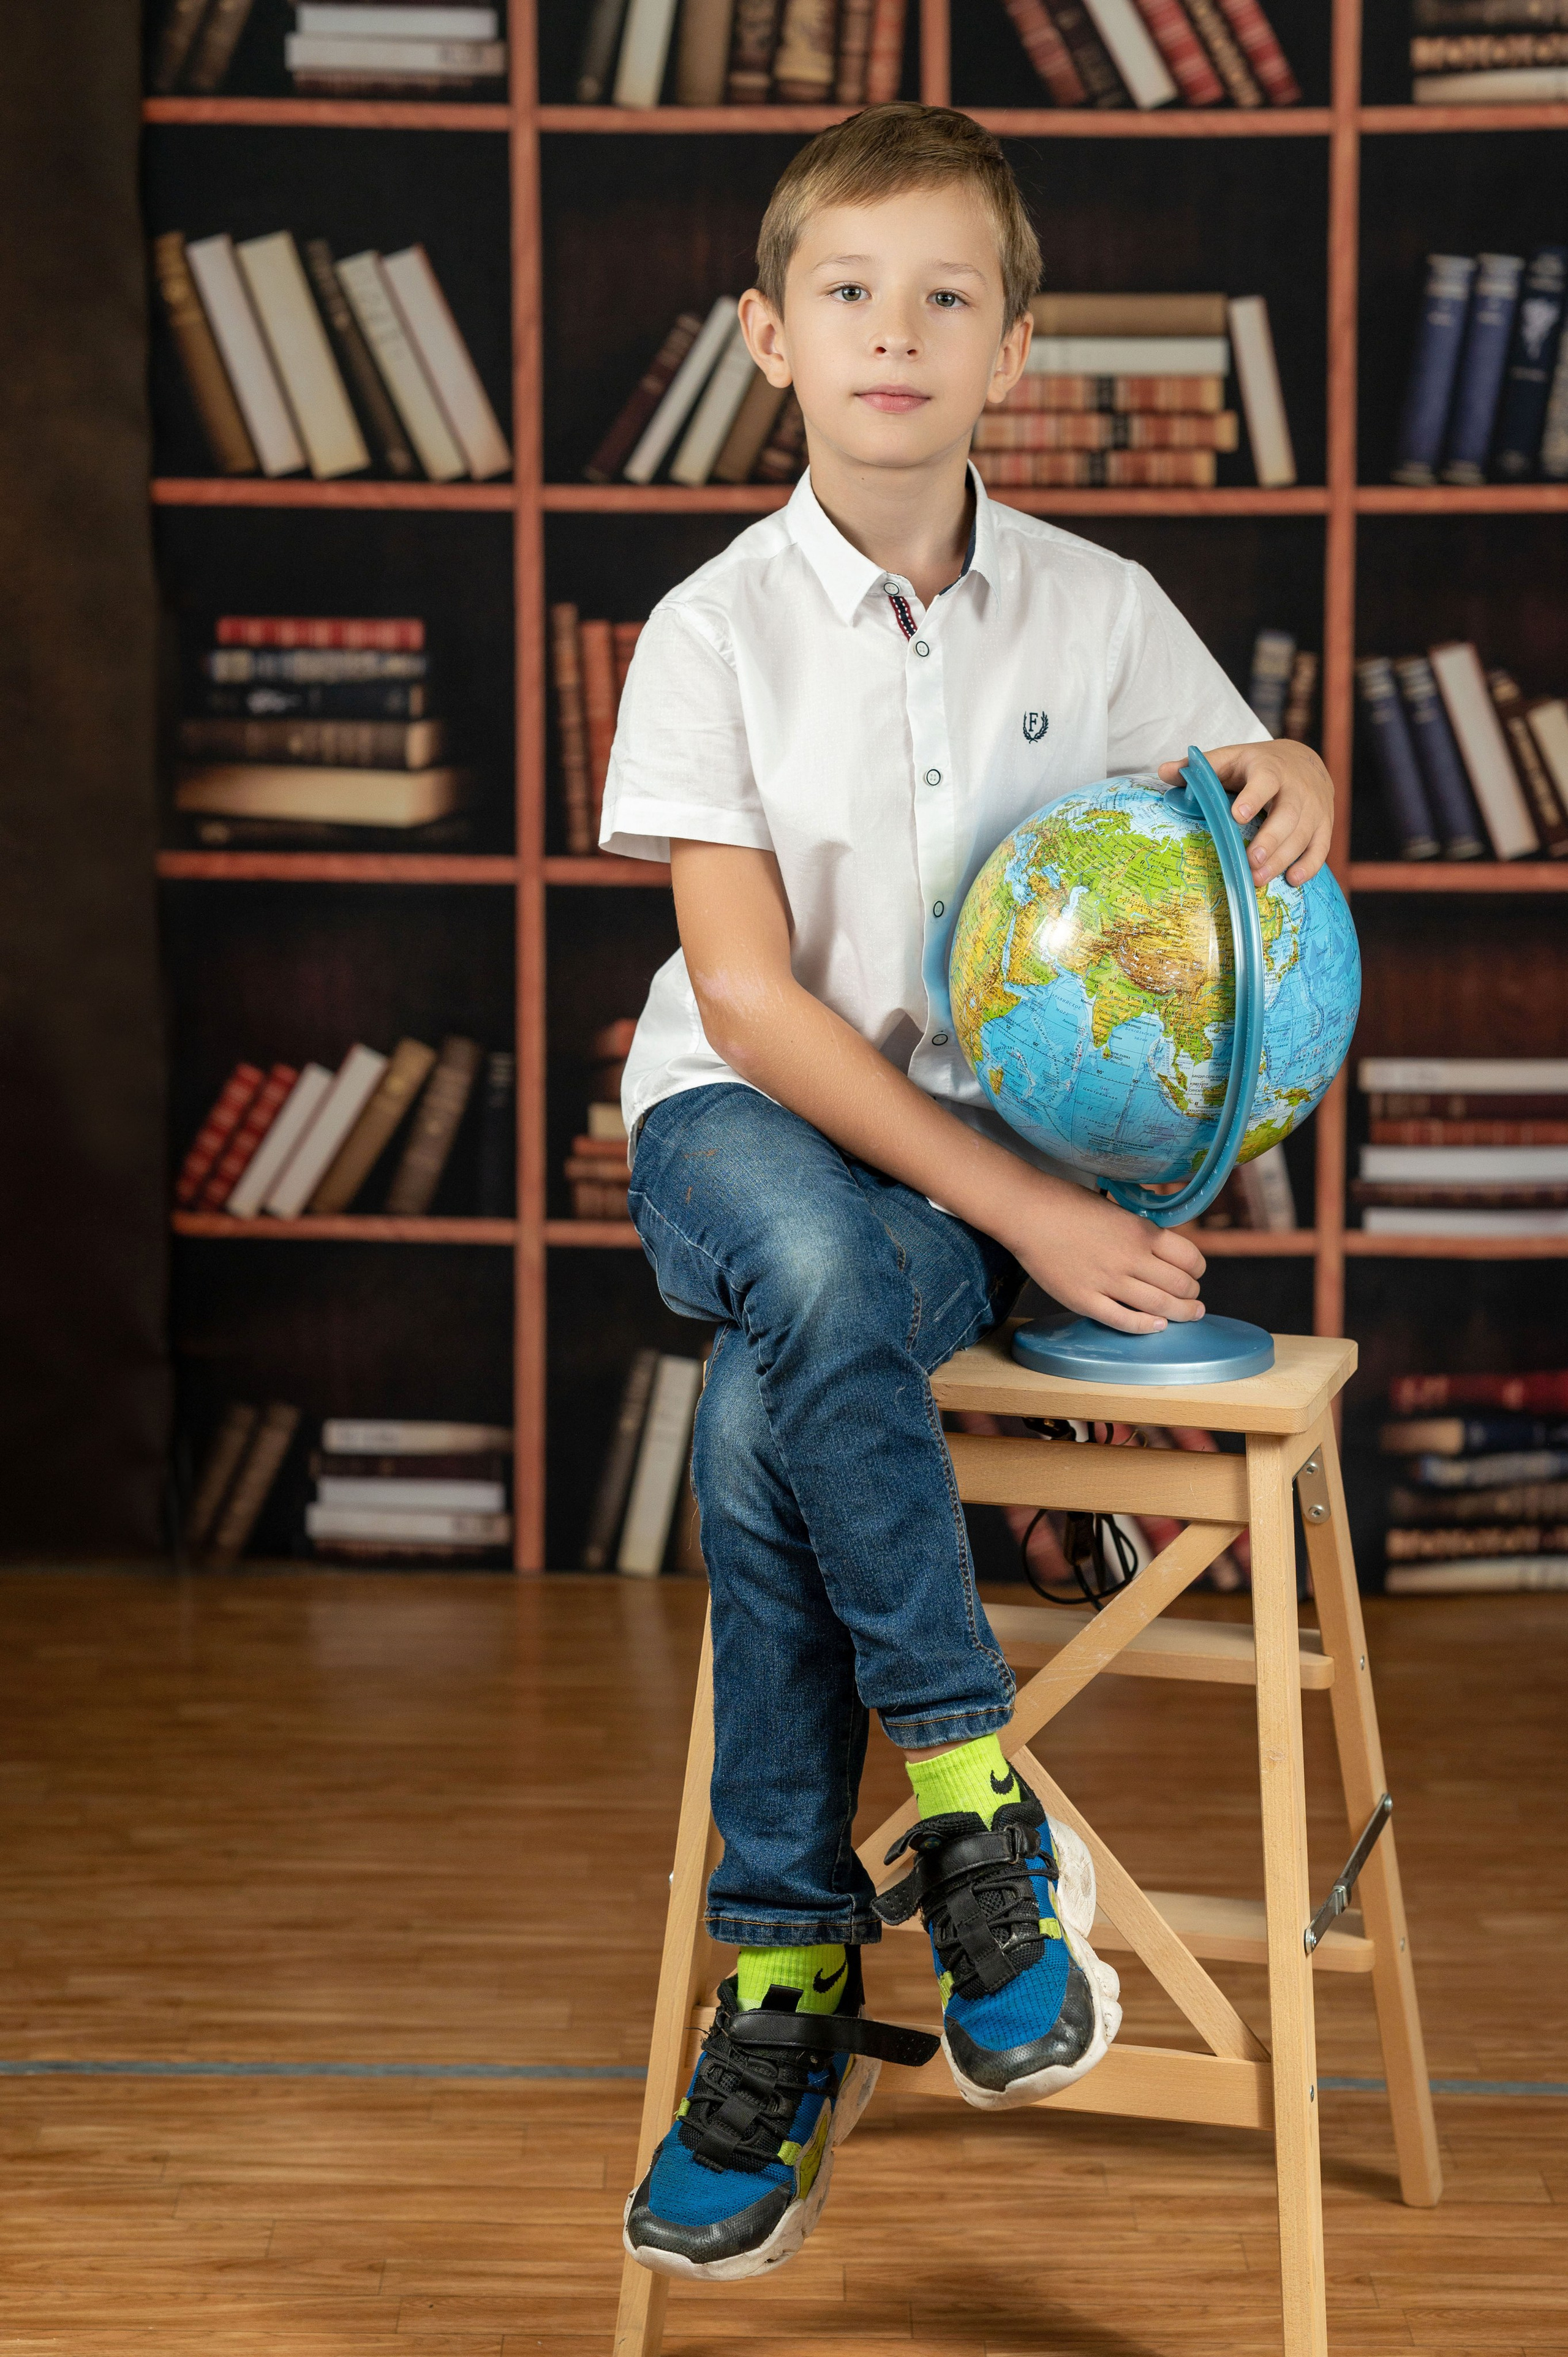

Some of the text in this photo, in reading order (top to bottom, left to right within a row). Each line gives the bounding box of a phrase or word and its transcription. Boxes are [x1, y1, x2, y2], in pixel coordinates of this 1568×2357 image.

[1029, 712, 1038, 731] F
[1125, 984, 1144, 994] КАТМАНДУ
[1051, 993, 1082, 1011] АРАВИЙСКОЕ
[1055, 1007, 1069, 1017] МОРЕ
[1125, 1026, 1156, 1037] Бенгальский
[1082, 1086, 1118, 1100] Центральная
[1080, 1116, 1107, 1126] котловина
[1087, 1131, 1115, 1142] УСЛОВНЫЕ
[1117, 1139, 1155, 1149] ОБОЗНАЧЕНИЯ
